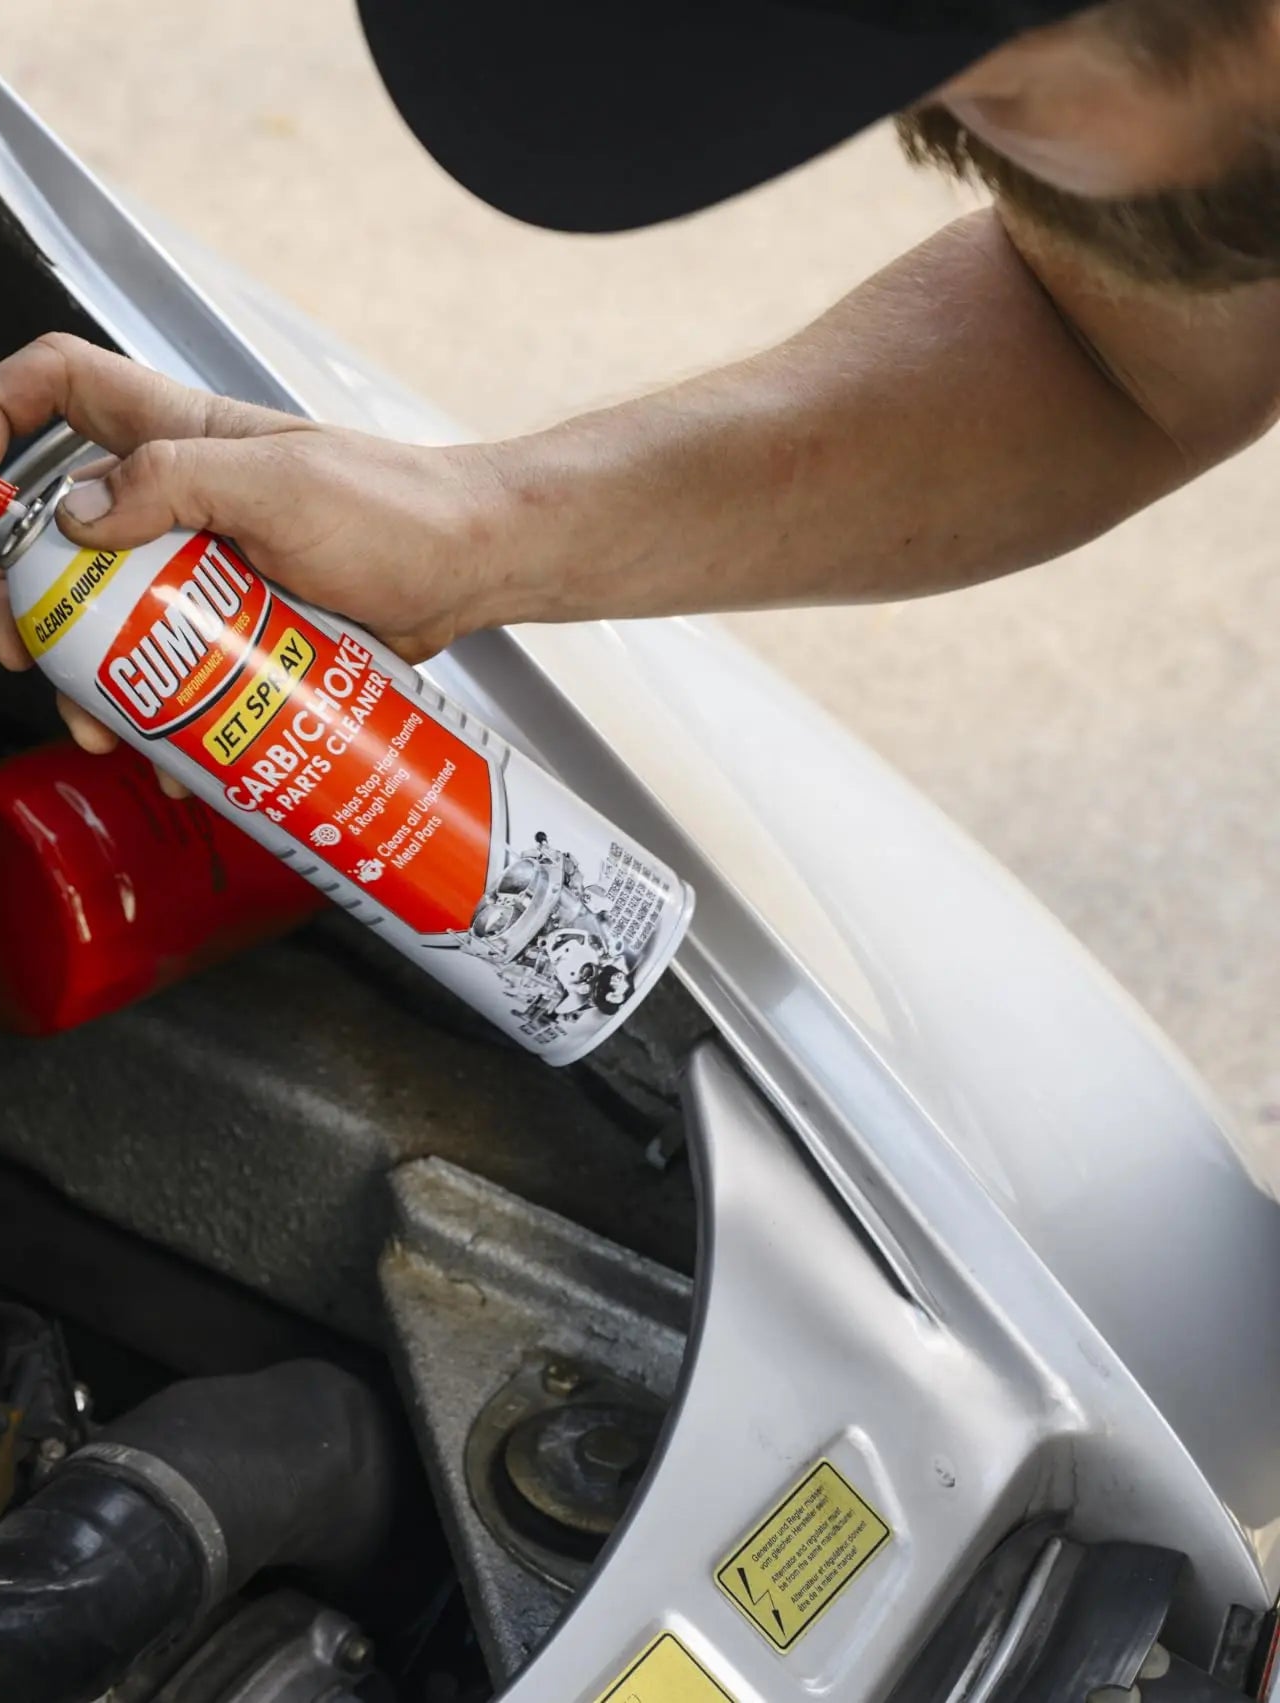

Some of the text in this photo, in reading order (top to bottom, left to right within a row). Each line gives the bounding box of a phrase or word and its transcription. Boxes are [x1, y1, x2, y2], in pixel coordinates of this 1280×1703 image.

[35, 598, 74, 643] CLEANS
[109, 540, 251, 719] GUMOUT
[177, 650, 225, 706] PERFORMANCE
[214, 637, 305, 757] JET SPRAY
[227, 635, 370, 811] CARB/CHOKE
[266, 672, 388, 823] & PARTS CLEANER
[333, 713, 422, 824] Helps Stop Hard Starting
[348, 768, 410, 835] & Rough Idling
[377, 759, 455, 856] Cleans all Unpainted
[392, 816, 442, 868] Metal Parts
[751, 1534, 778, 1562] Generator
[777, 1522, 789, 1535] und
[786, 1505, 805, 1524] Regler
[760, 1557, 772, 1570] vom
[771, 1534, 792, 1559] gleichen
[791, 1509, 816, 1535] Hersteller
[771, 1507, 841, 1582] Alternator and regulator must
[778, 1581, 788, 1591] be
[785, 1569, 800, 1583] from
[798, 1560, 808, 1570] the
[807, 1544, 822, 1561] same
[791, 1574, 818, 1603] Alternateur
[818, 1566, 825, 1574] et
[848, 1520, 866, 1542] doivent
[809, 1591, 817, 1601] de
